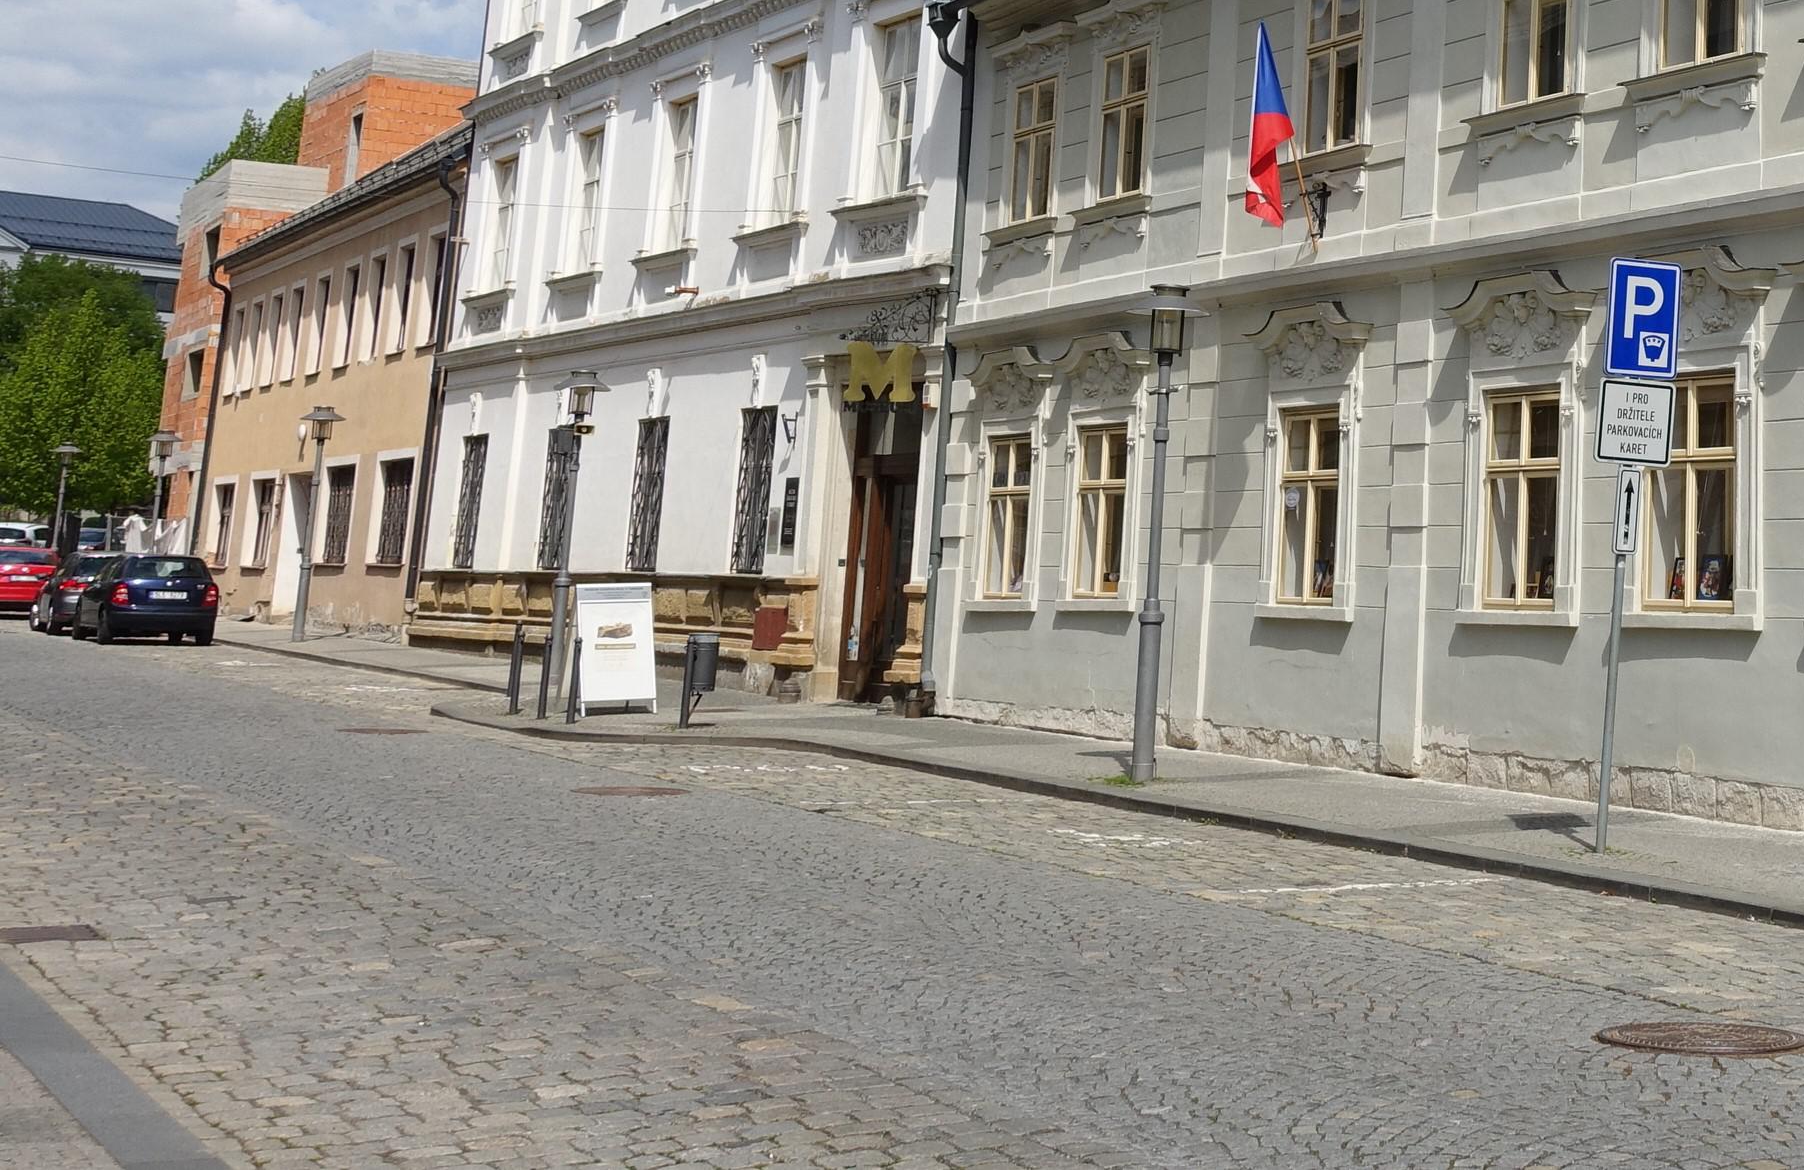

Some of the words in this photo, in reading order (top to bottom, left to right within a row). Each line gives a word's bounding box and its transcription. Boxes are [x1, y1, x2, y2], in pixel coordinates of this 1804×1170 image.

[1623, 275, 1664, 339] P
[843, 341, 917, 403] M
[1625, 392, 1629, 403] I
[1632, 392, 1649, 404] PRO
[1617, 407, 1656, 422] DRŽITELE
[1606, 423, 1663, 440] PARKOVACÍCH
[1619, 442, 1648, 455] KARET
